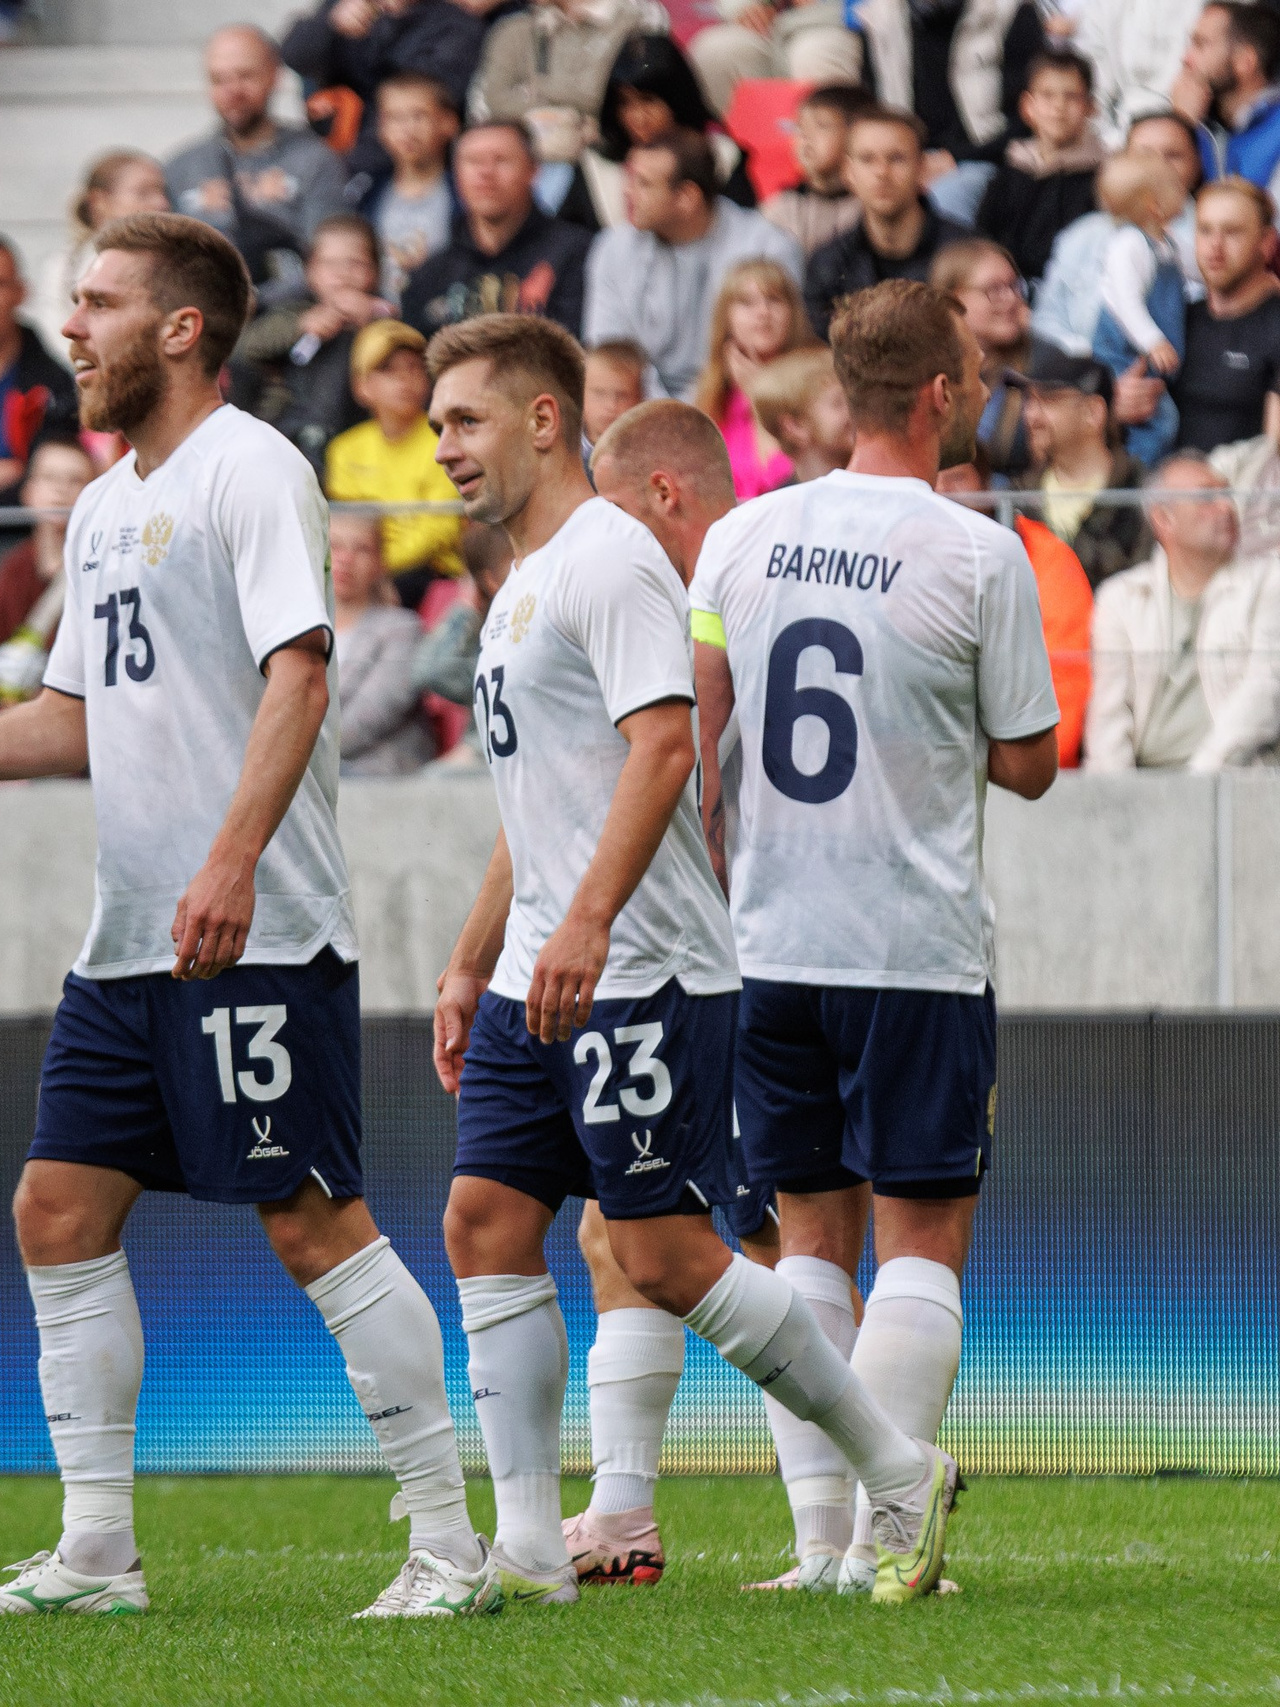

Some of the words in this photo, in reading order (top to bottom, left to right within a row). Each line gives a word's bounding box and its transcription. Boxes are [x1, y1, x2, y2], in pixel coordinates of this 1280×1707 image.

[767, 543, 903, 593] BARINOV
[94, 586, 156, 687] 13
[762, 616, 864, 804] 6
[201, 1004, 292, 1103] 13
[573, 1021, 673, 1124] 23
